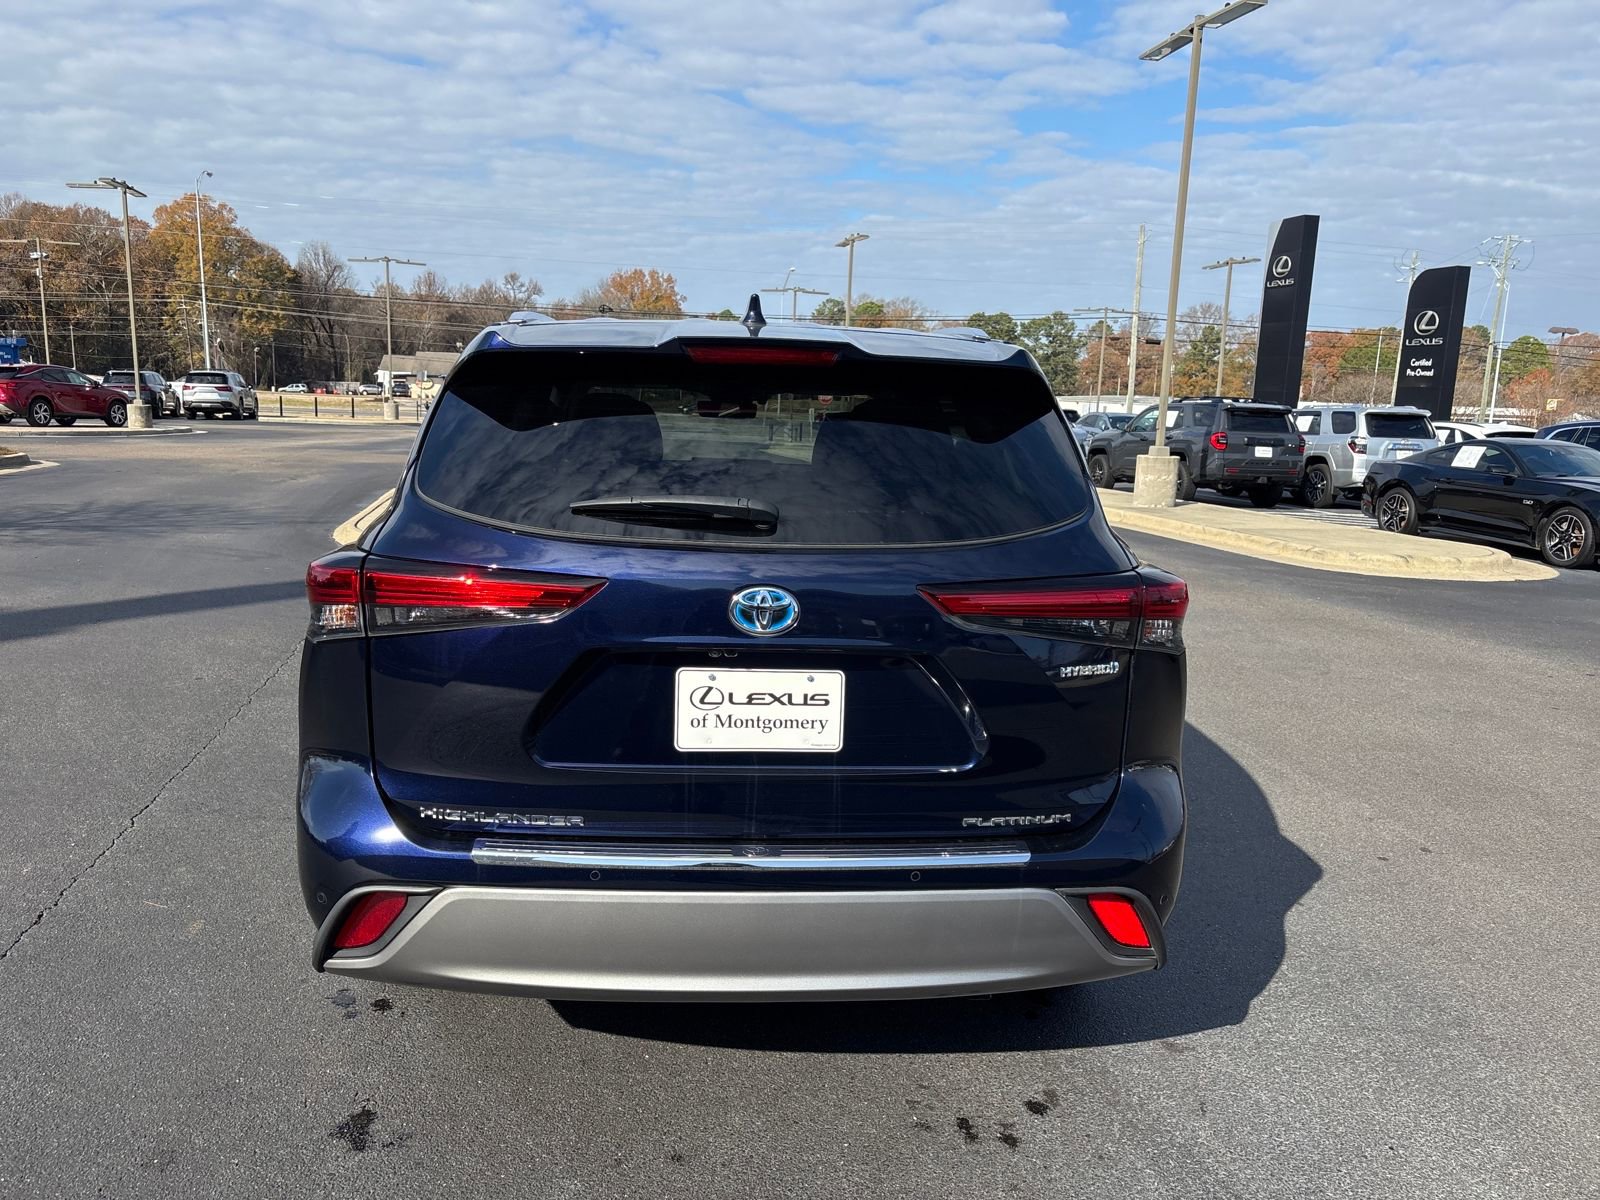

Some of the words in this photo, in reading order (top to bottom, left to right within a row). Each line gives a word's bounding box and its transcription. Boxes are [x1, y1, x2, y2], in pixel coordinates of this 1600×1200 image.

[1266, 277, 1295, 288] LEXUS
[1405, 337, 1443, 346] LEXUS
[1410, 358, 1432, 367] Certified
[1406, 368, 1434, 377] Pre-Owned
[1060, 664, 1111, 677] HYBRID
[728, 692, 831, 707] LEXUS
[690, 713, 709, 728] of
[714, 714, 829, 734] Montgomery
[419, 806, 585, 827] HIGHLANDER
[962, 813, 1072, 827] PLATINUM
